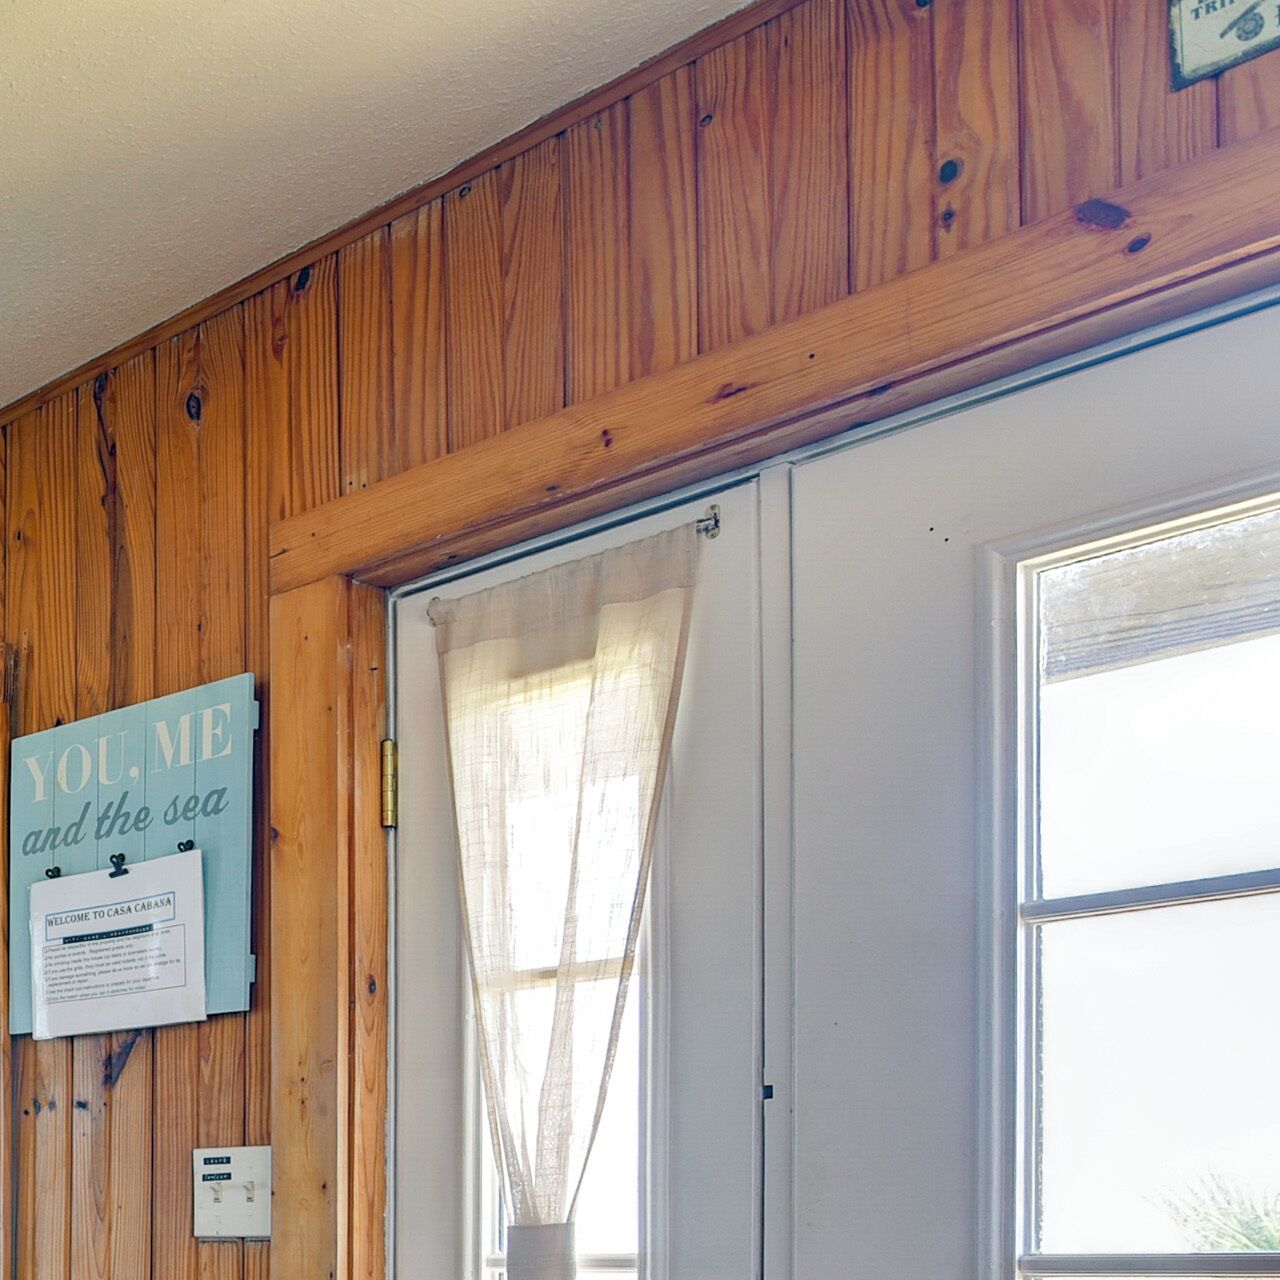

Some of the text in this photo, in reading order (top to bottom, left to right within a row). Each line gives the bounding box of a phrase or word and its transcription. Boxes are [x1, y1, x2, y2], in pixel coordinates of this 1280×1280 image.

[21, 703, 232, 804] YOU, ME
[21, 786, 229, 856] and the sea
[47, 897, 172, 927] WELCOME TO CASA CABANA
